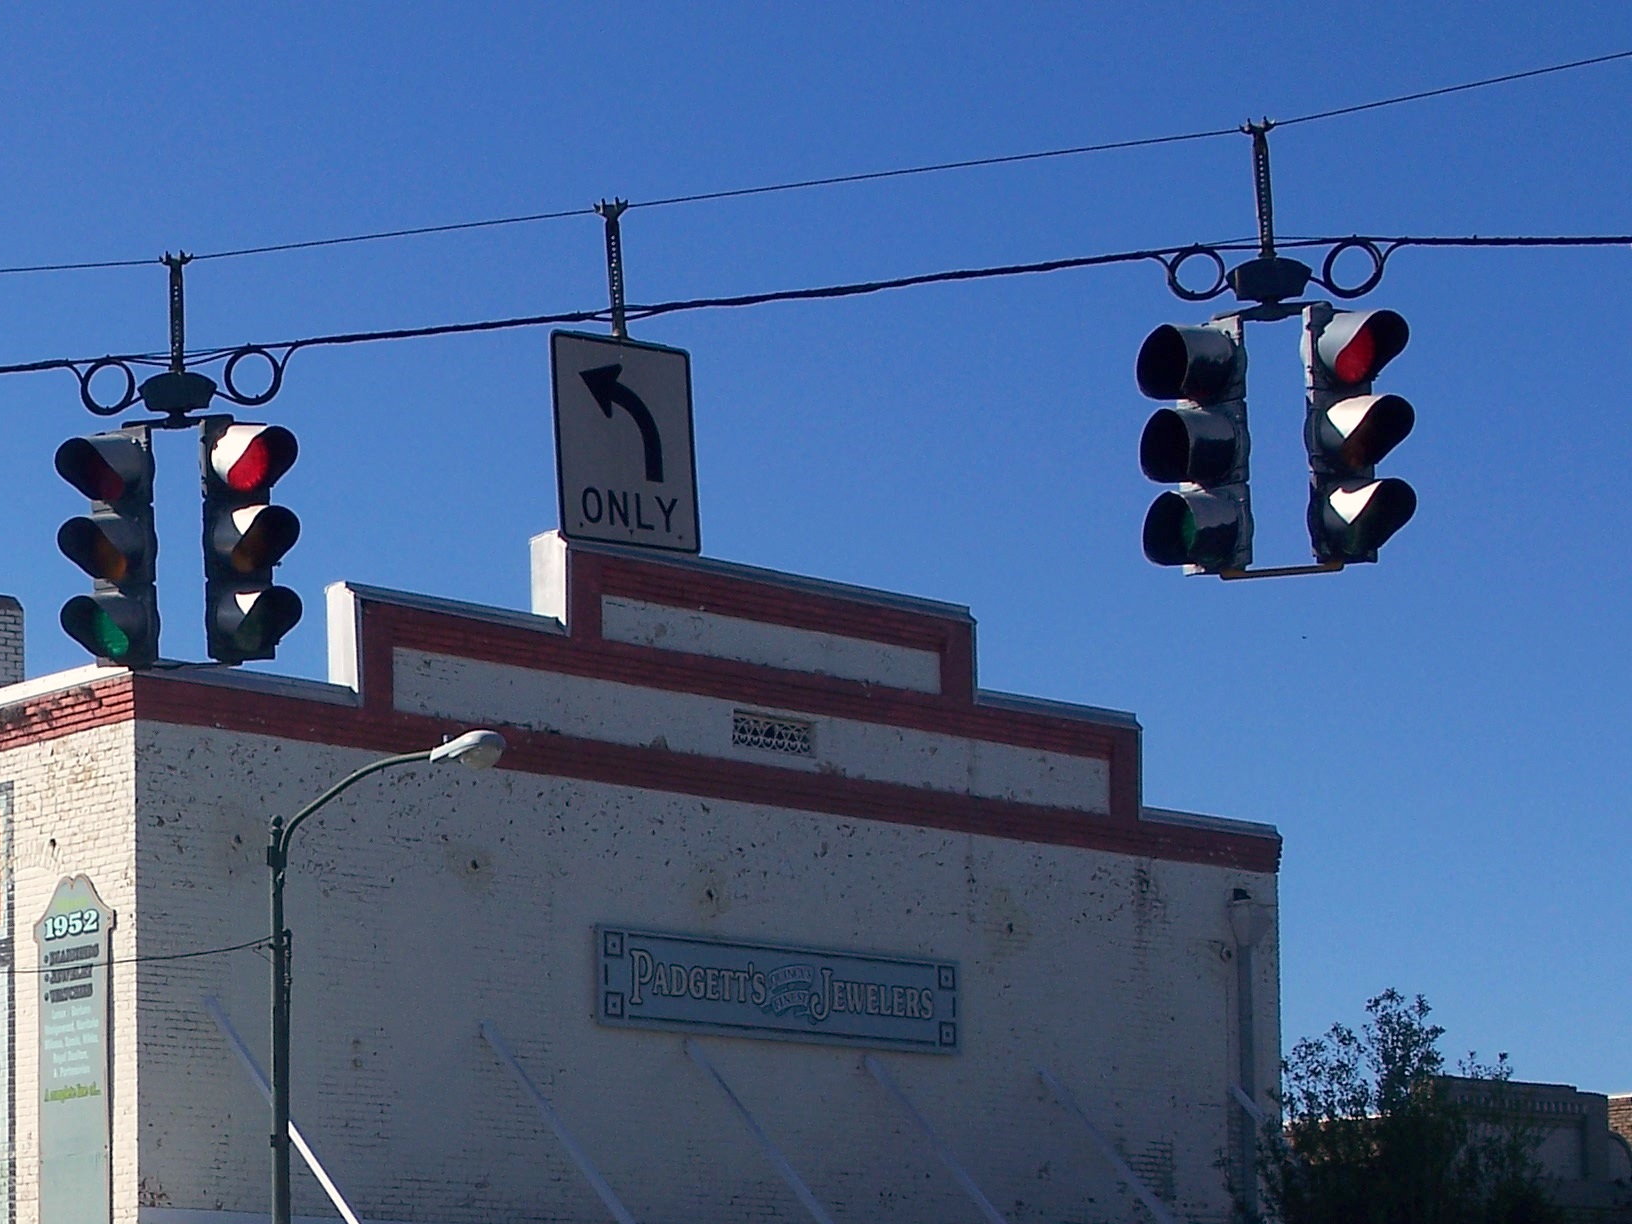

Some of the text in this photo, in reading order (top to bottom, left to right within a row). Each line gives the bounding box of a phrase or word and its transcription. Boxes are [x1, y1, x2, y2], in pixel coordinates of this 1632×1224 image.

[581, 486, 678, 533] ONLY
[45, 908, 100, 941] 1952
[628, 948, 934, 1020] PADGETT'S JEWELERS
